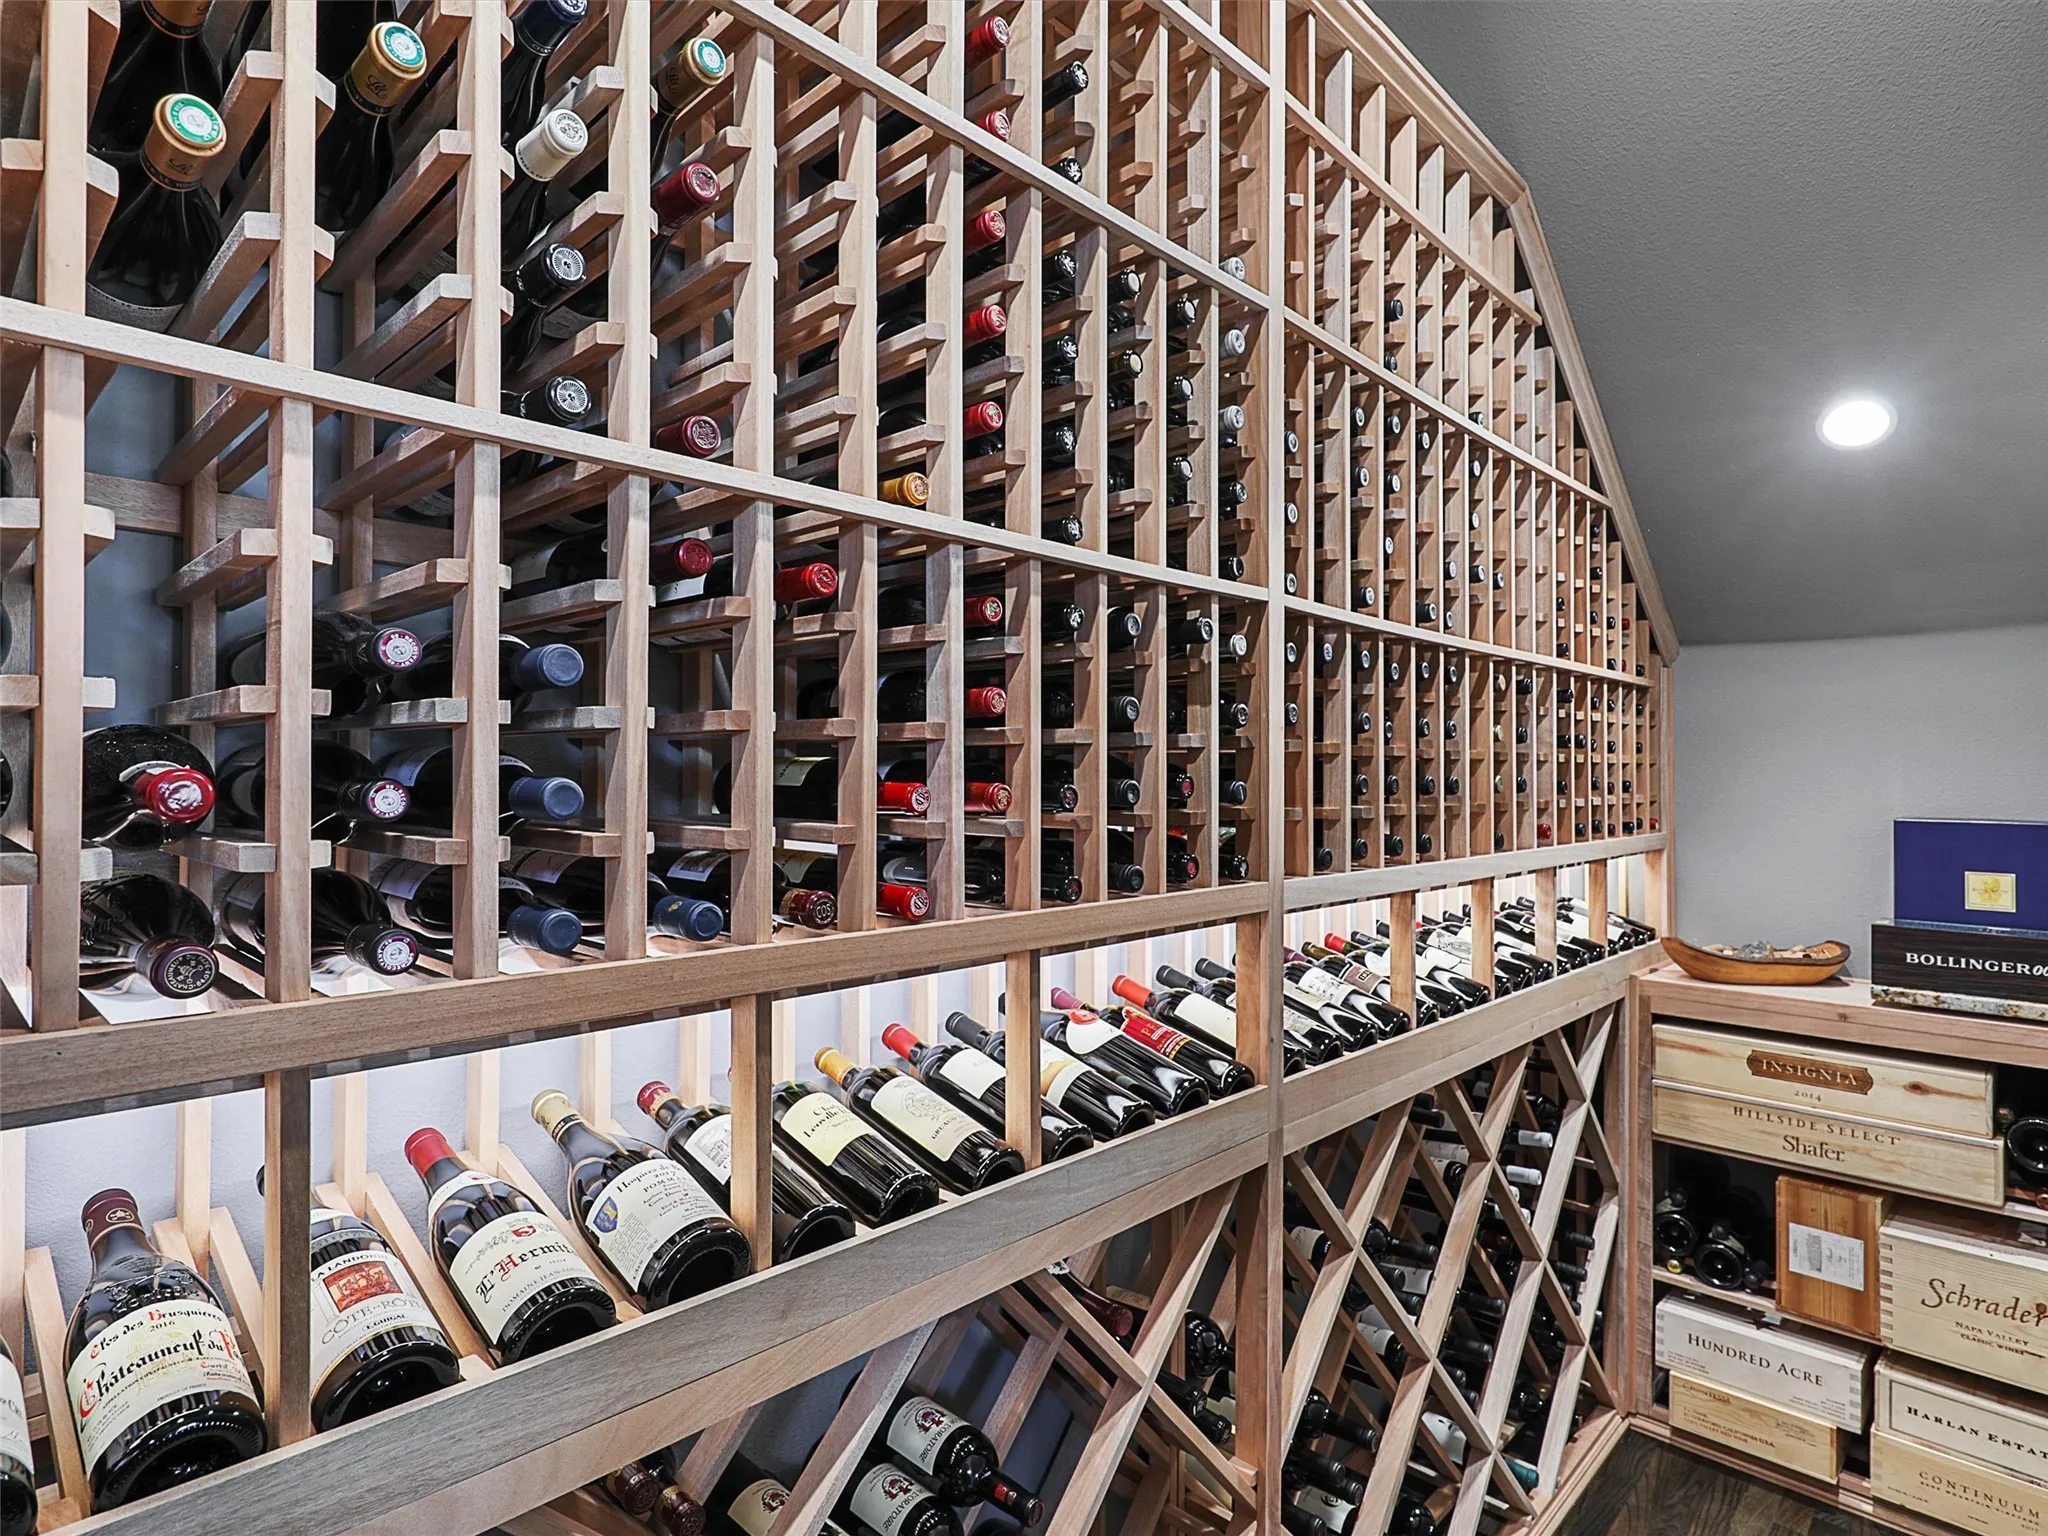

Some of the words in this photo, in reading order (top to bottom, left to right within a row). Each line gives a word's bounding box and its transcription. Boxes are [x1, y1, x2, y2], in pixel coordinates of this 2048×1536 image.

[1762, 1059, 1858, 1086] INSIGNIA
[1794, 1090, 1822, 1102] 2014
[1733, 1106, 1818, 1131] HILLSIDE
[1827, 1124, 1899, 1145] SELECT
[1921, 1278, 2048, 1327] Schrader
[122, 1320, 144, 1335] des
[150, 1320, 175, 1332] 2016
[1955, 1321, 1983, 1334] NAPA
[1987, 1329, 2029, 1346] VALLEY
[208, 1339, 224, 1352] du
[1688, 1333, 1770, 1369] HUNDRED
[1777, 1363, 1824, 1387] ACRE
[1907, 1406, 1979, 1436] HARLAN
[1987, 1433, 2048, 1460] ESTAT
[1919, 1471, 2040, 1519] CONTINUUM
